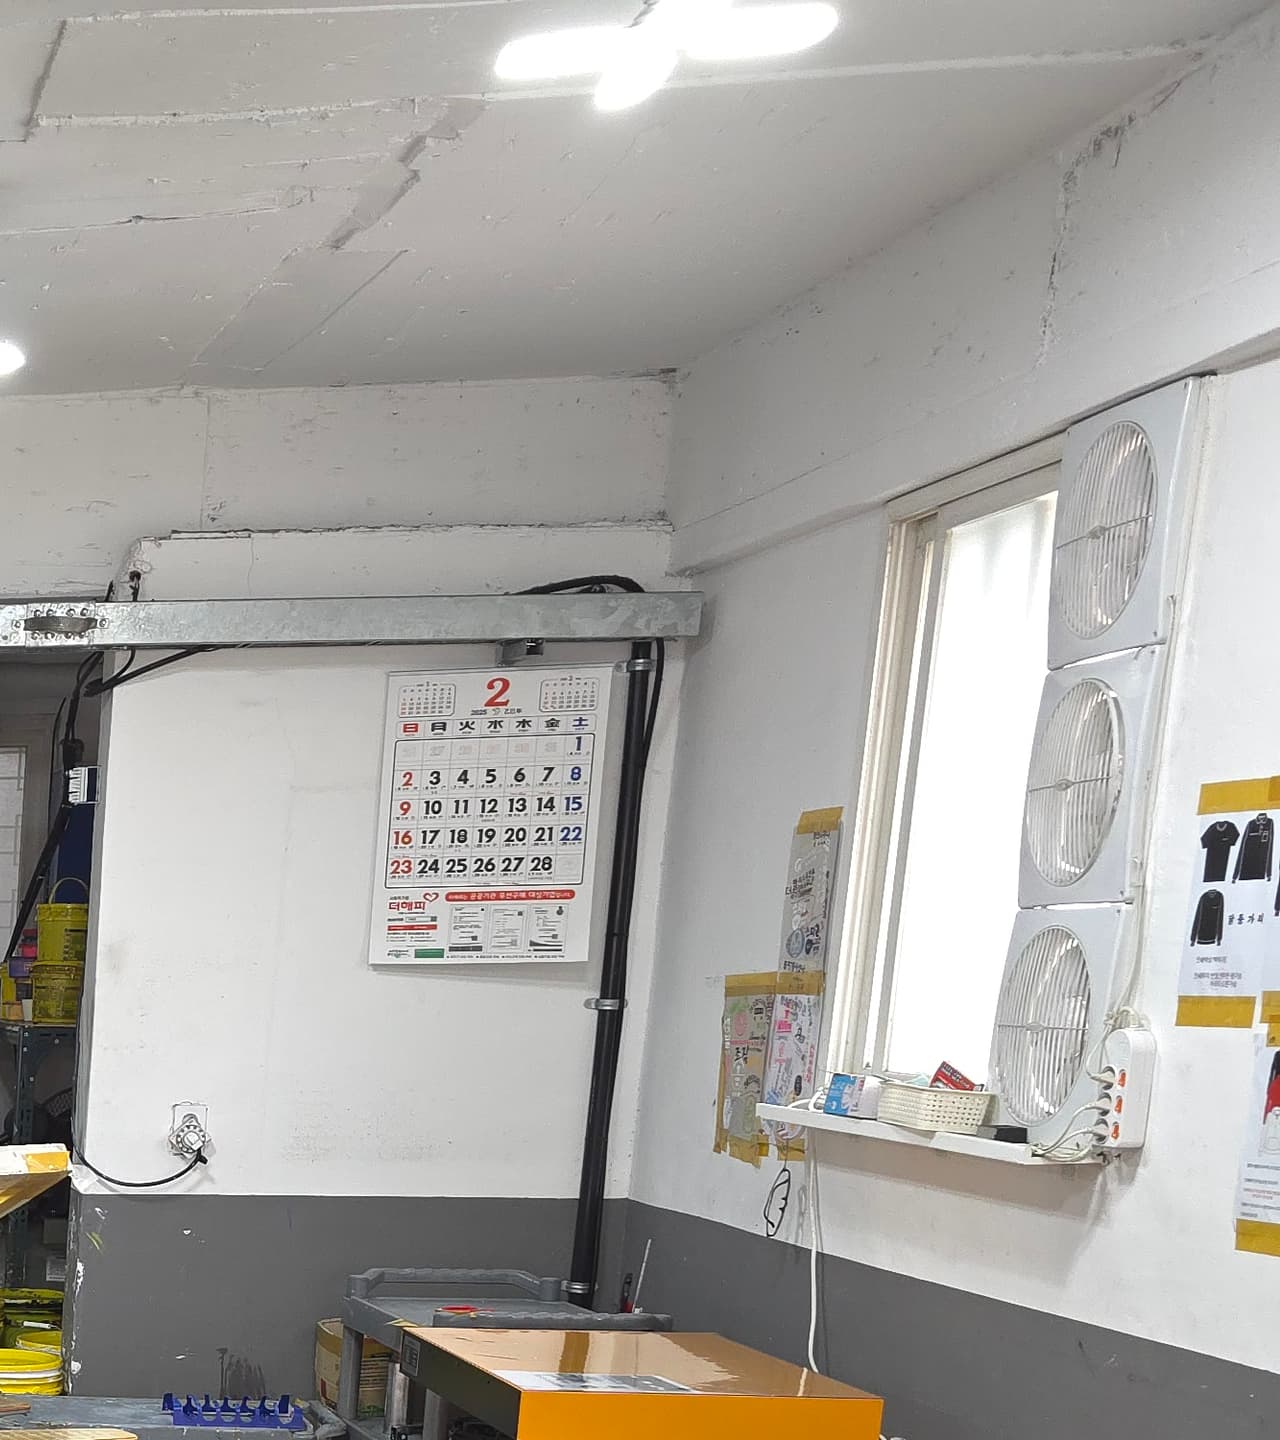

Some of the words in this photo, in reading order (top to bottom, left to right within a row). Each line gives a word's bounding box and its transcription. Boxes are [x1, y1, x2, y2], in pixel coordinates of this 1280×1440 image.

[483, 677, 511, 708] 2
[402, 723, 419, 733] 日
[458, 721, 476, 731] 火
[487, 720, 504, 730] 水
[515, 719, 532, 729] 木
[544, 718, 561, 728] 金
[572, 717, 589, 727] 土
[575, 736, 582, 751] 1
[402, 772, 413, 787] 2
[429, 771, 441, 785] 3
[457, 770, 470, 785] 4
[485, 769, 497, 783] 5
[514, 768, 526, 782] 6
[543, 767, 555, 781] 7
[571, 766, 582, 781] 8
[399, 801, 411, 816] 9
[423, 800, 442, 815] 10
[453, 799, 468, 814] 11
[480, 798, 498, 813] 12
[508, 797, 527, 812] 13
[536, 797, 555, 812] 14
[564, 796, 583, 811] 15
[393, 830, 412, 845] 16
[421, 830, 440, 844] 17
[449, 829, 468, 844] 18
[477, 828, 496, 843] 19
[504, 827, 527, 842] 20
[535, 827, 553, 842] 21
[560, 826, 582, 841] 22
[390, 860, 412, 874] 23
[417, 859, 440, 874] 24
[446, 858, 468, 873] 25
[473, 857, 496, 872] 26
[501, 857, 525, 872] 27
[530, 856, 553, 871] 28
